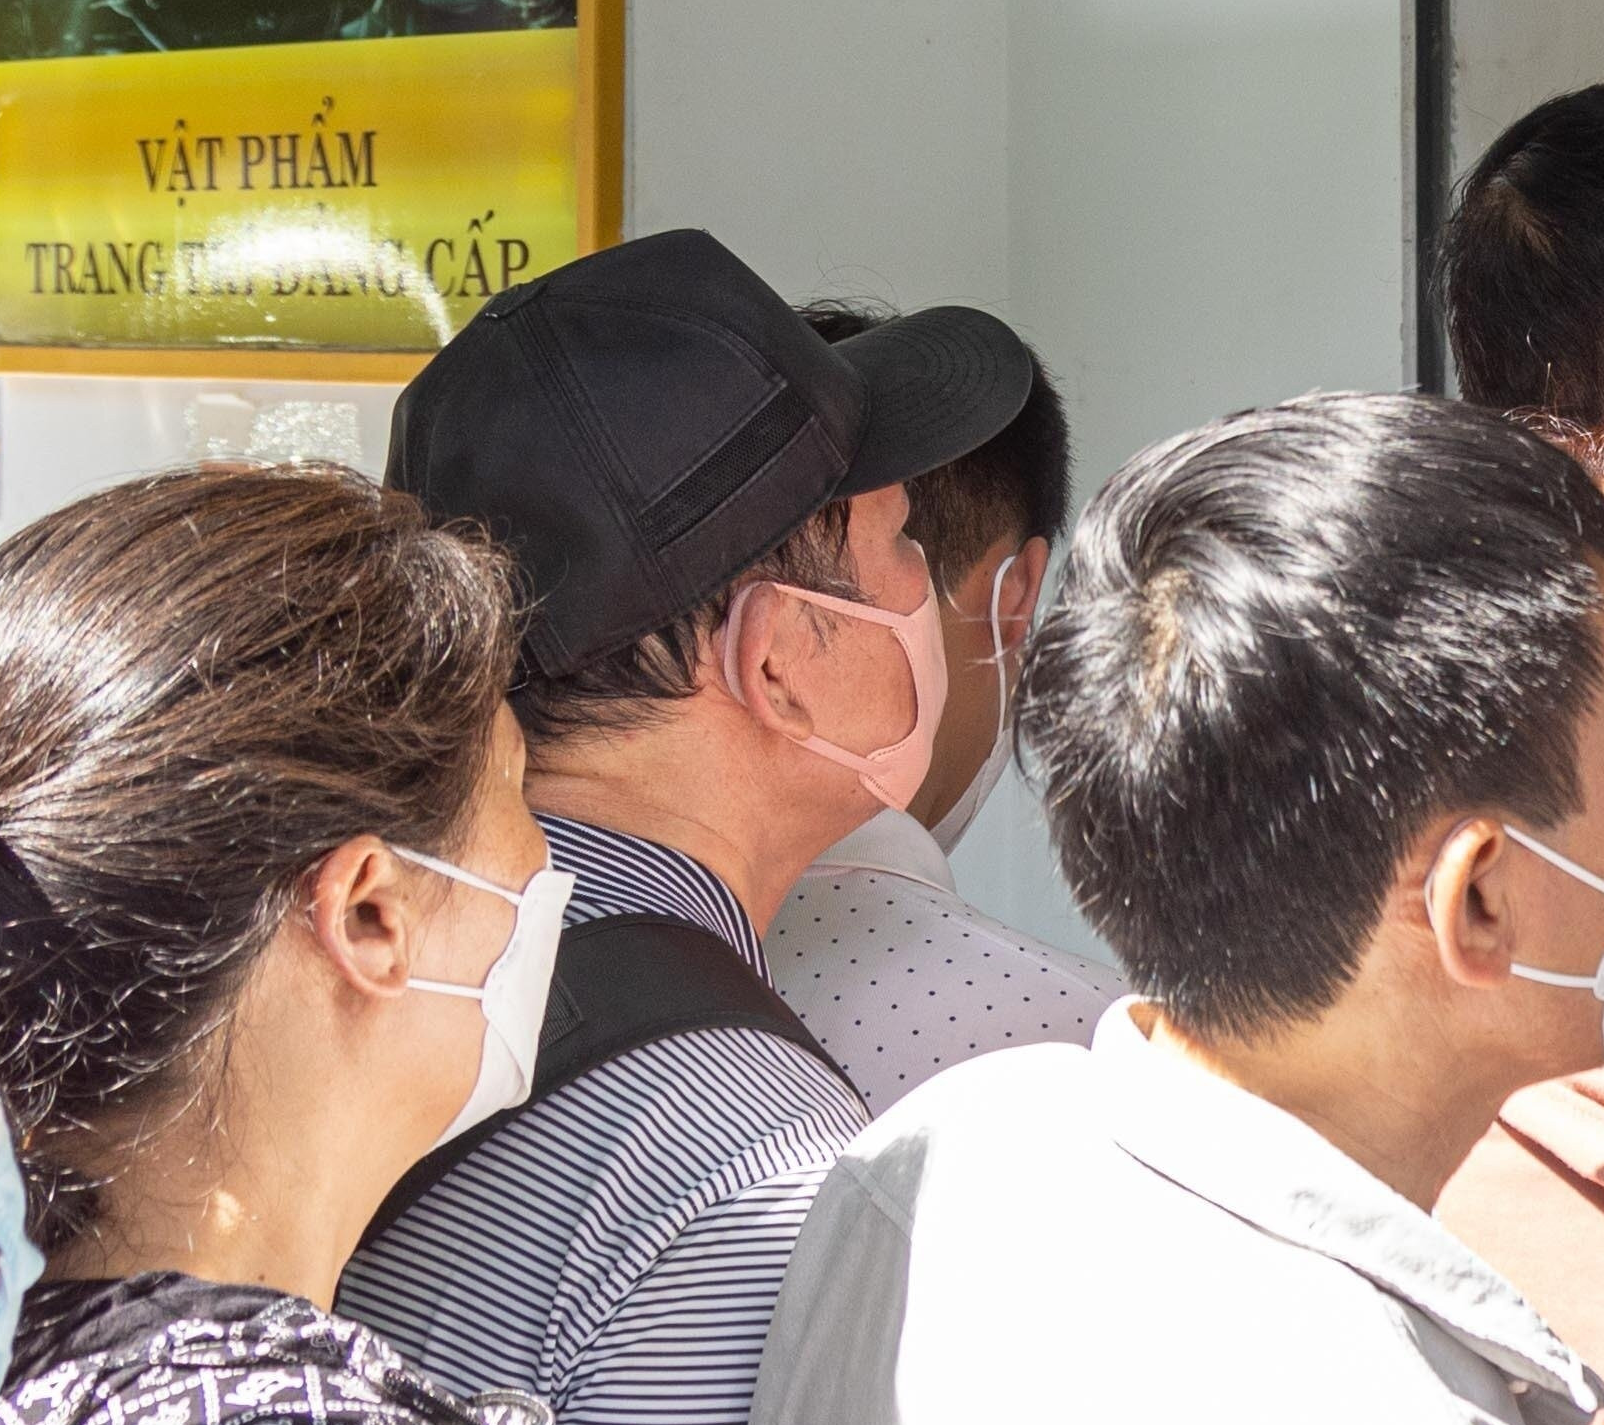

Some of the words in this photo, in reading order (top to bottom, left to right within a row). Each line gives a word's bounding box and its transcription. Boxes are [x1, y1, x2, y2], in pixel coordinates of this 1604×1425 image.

[136, 119, 224, 206] VẬT
[238, 96, 379, 189] PHẨM
[25, 241, 167, 297] TRANG
[426, 210, 530, 298] CẤP
